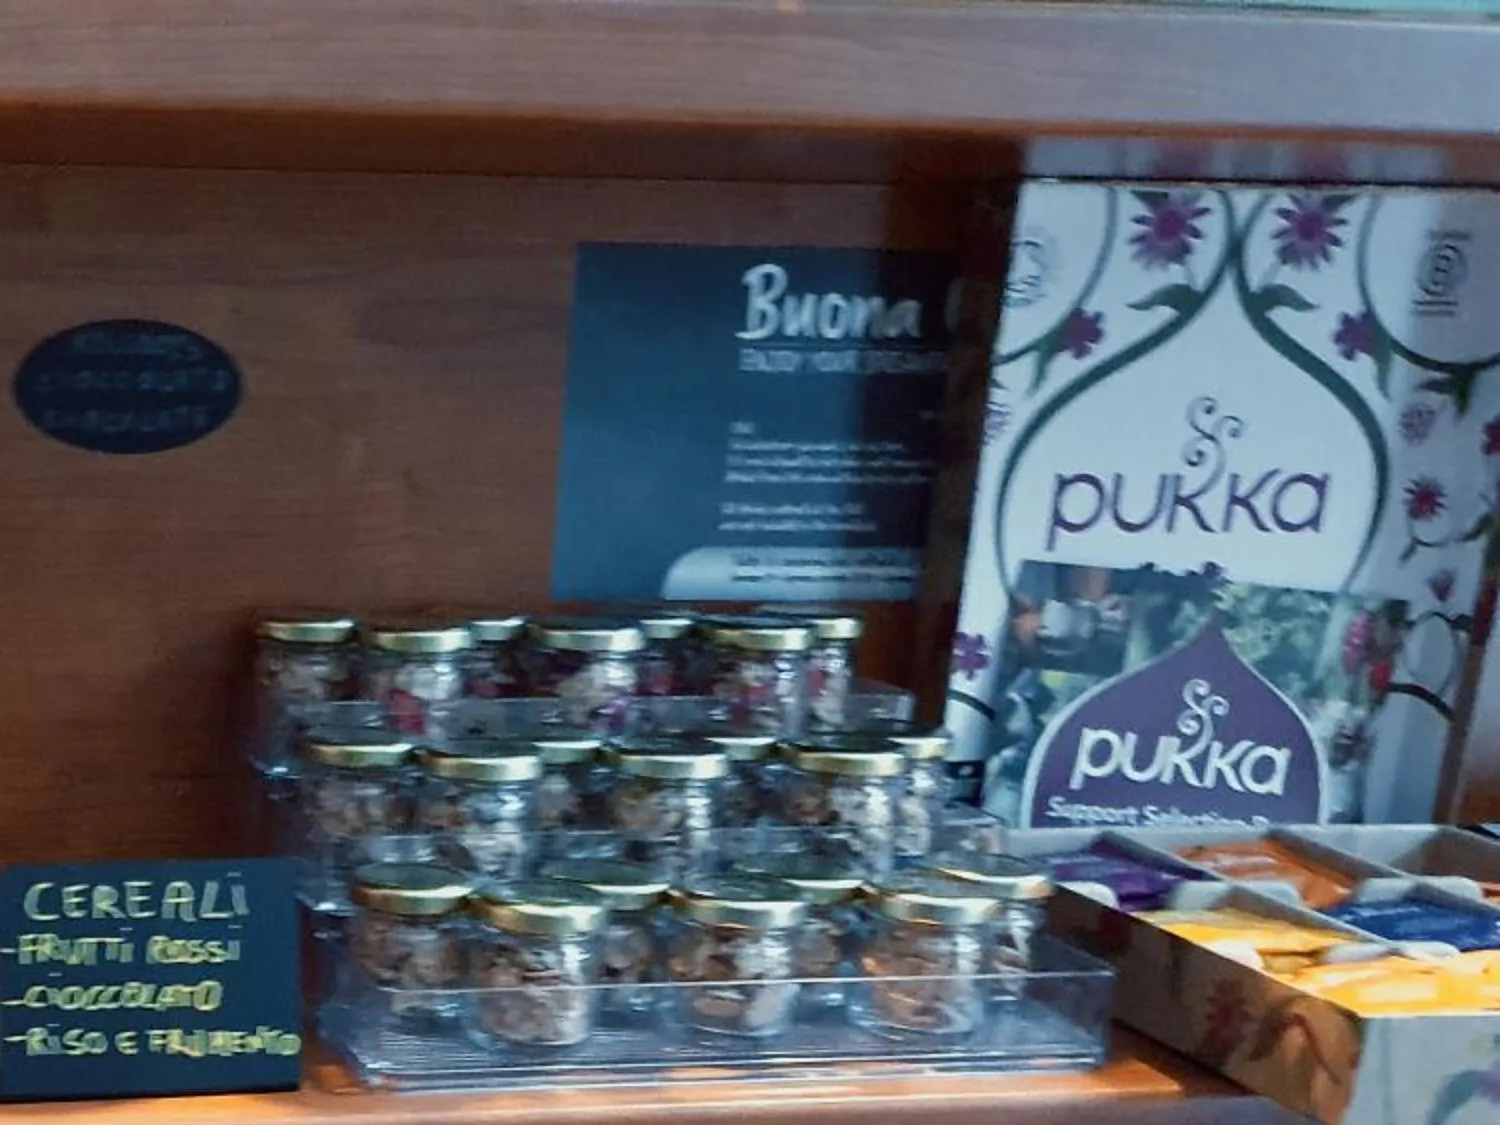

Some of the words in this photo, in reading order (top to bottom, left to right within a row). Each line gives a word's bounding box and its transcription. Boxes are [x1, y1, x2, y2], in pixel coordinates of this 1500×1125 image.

[734, 263, 924, 339] Buona
[1047, 462, 1330, 552] pukka
[1069, 720, 1293, 797] pukka
[1045, 796, 1140, 826] Support
